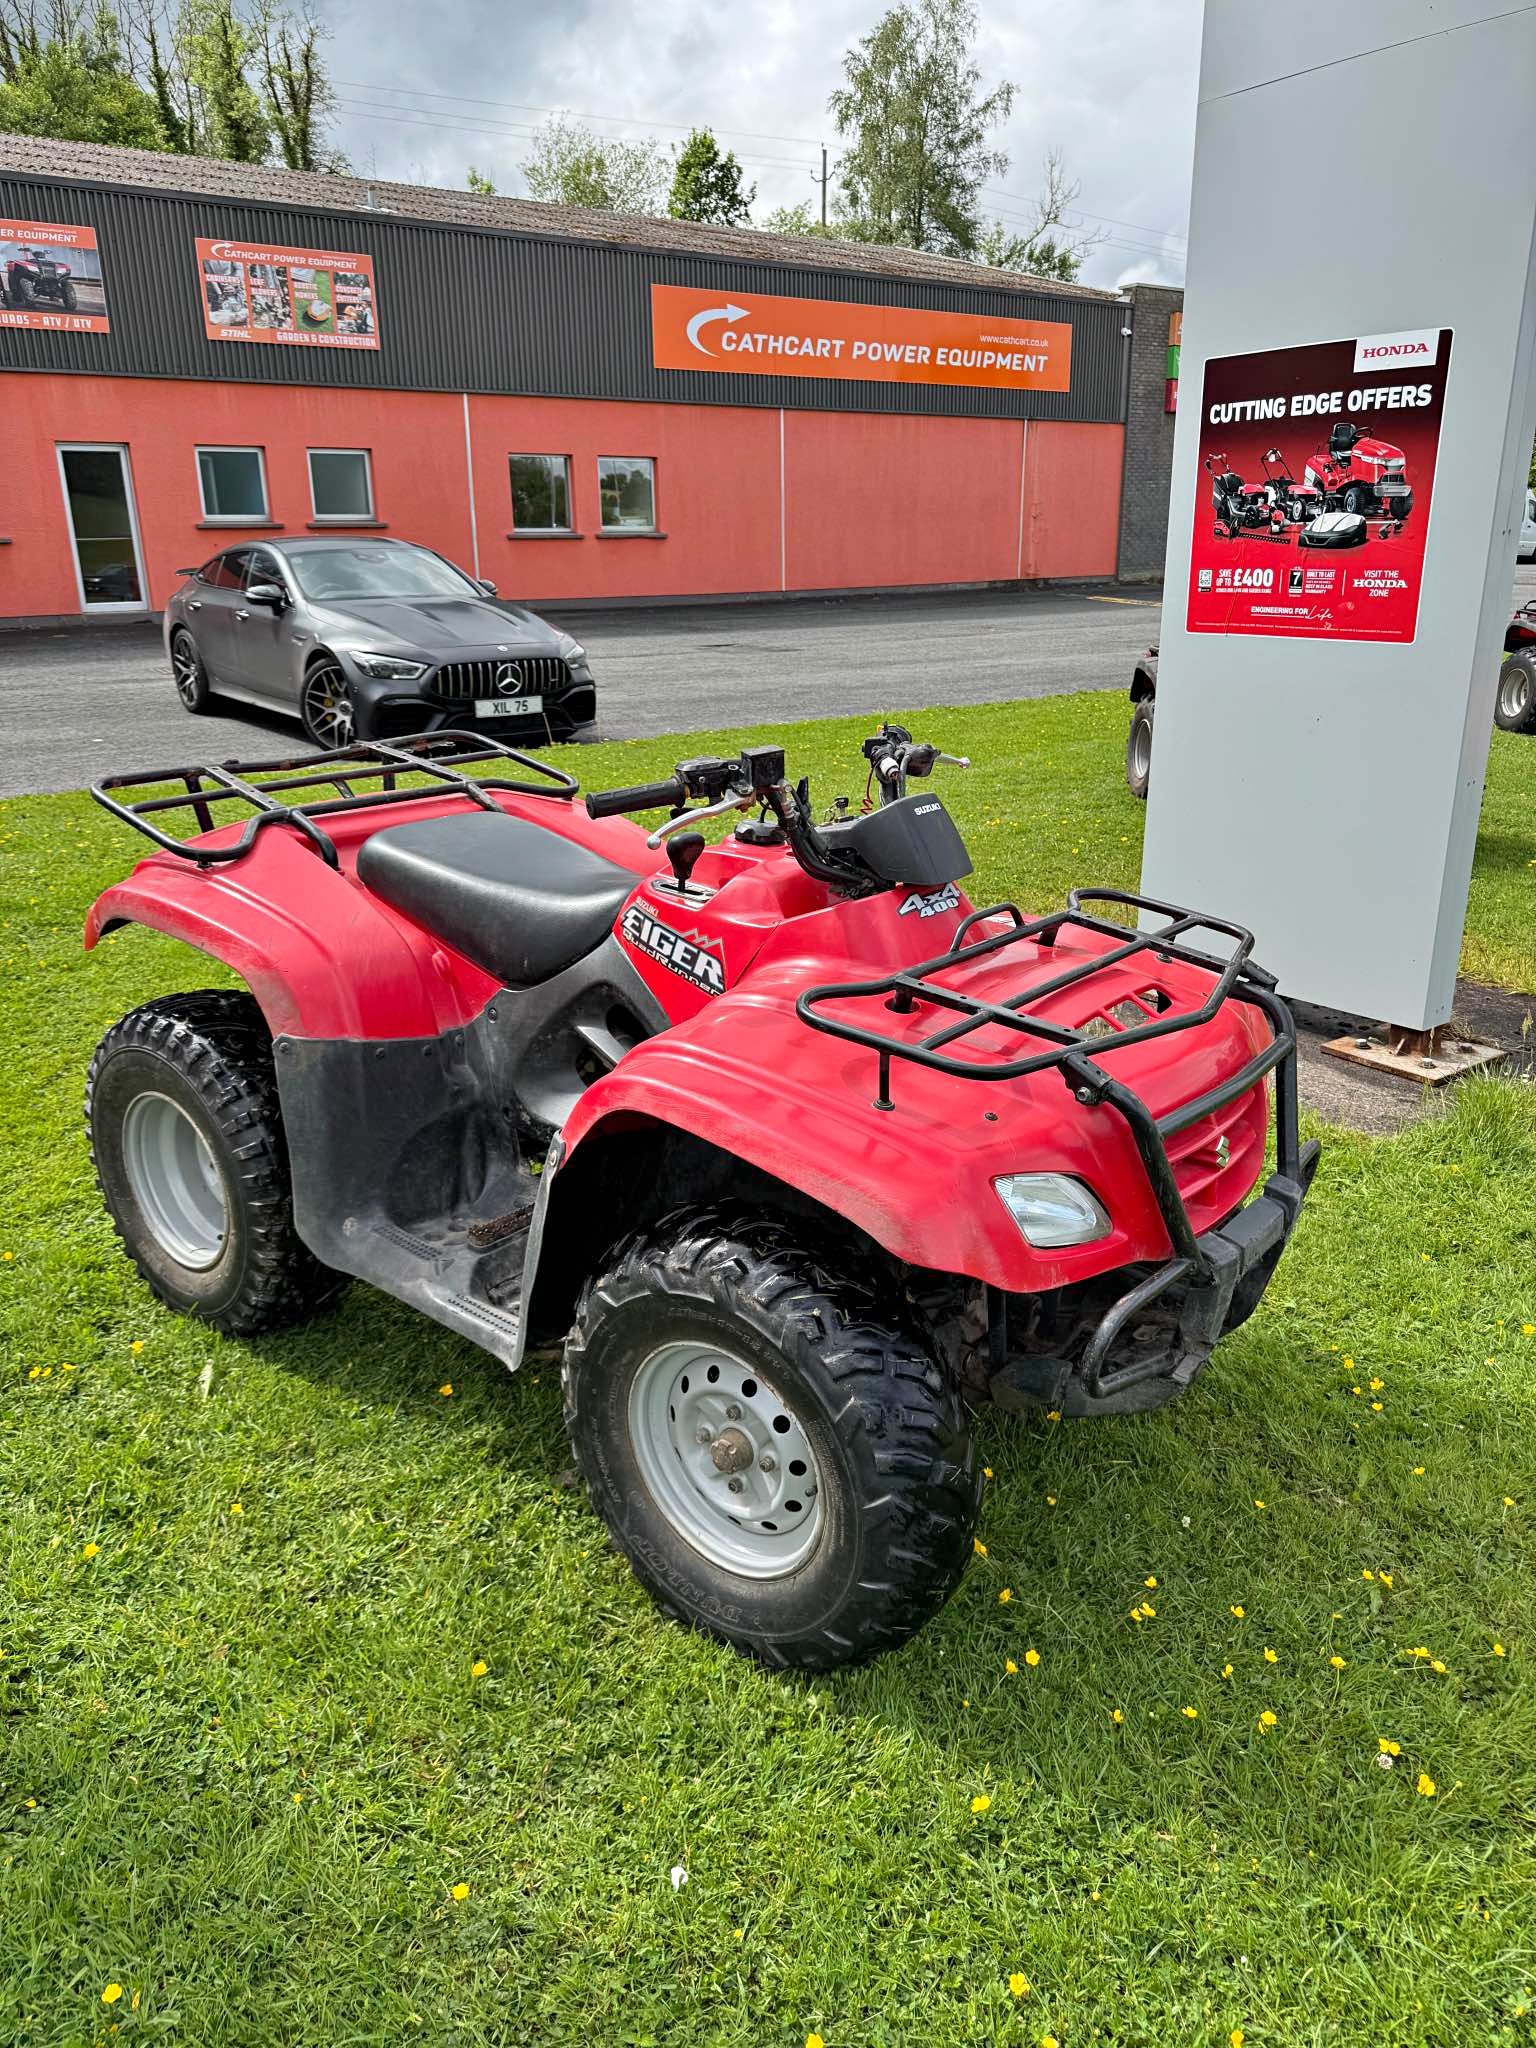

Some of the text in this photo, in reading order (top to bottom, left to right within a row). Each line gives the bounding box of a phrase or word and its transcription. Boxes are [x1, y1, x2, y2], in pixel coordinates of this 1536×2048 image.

[18, 230, 78, 243] EQUIPMENT
[224, 249, 272, 262] CATHCART
[274, 254, 306, 265] POWER
[308, 258, 358, 270] EQUIPMENT
[43, 316, 61, 327] ATV
[73, 318, 92, 329] UTV
[220, 329, 251, 339] STIHL
[277, 331, 376, 347] GARDEN & CONSTRUCTION
[979, 334, 1049, 348] www.cathcart.co.uk
[721, 331, 1049, 373] CATHCART POWER EQUIPMENT
[1362, 343, 1429, 359] HONDA
[1209, 384, 1433, 424] CUTTING EDGE OFFERS
[1219, 569, 1233, 578] SAVE
[1233, 568, 1274, 587] £400
[1293, 571, 1301, 585] 7
[1364, 570, 1399, 578] VISIT THE
[1216, 578, 1232, 586] UP TO
[1353, 579, 1408, 589] HONDA
[1369, 589, 1389, 597] ZONE
[1251, 606, 1294, 614] ENGINEERING
[1305, 605, 1334, 620] Life
[492, 700, 528, 714] XIL 75
[914, 802, 942, 816] SUZUKI
[636, 895, 659, 917] SUZUKI
[919, 897, 959, 918] 400
[621, 907, 725, 990] EIGER
